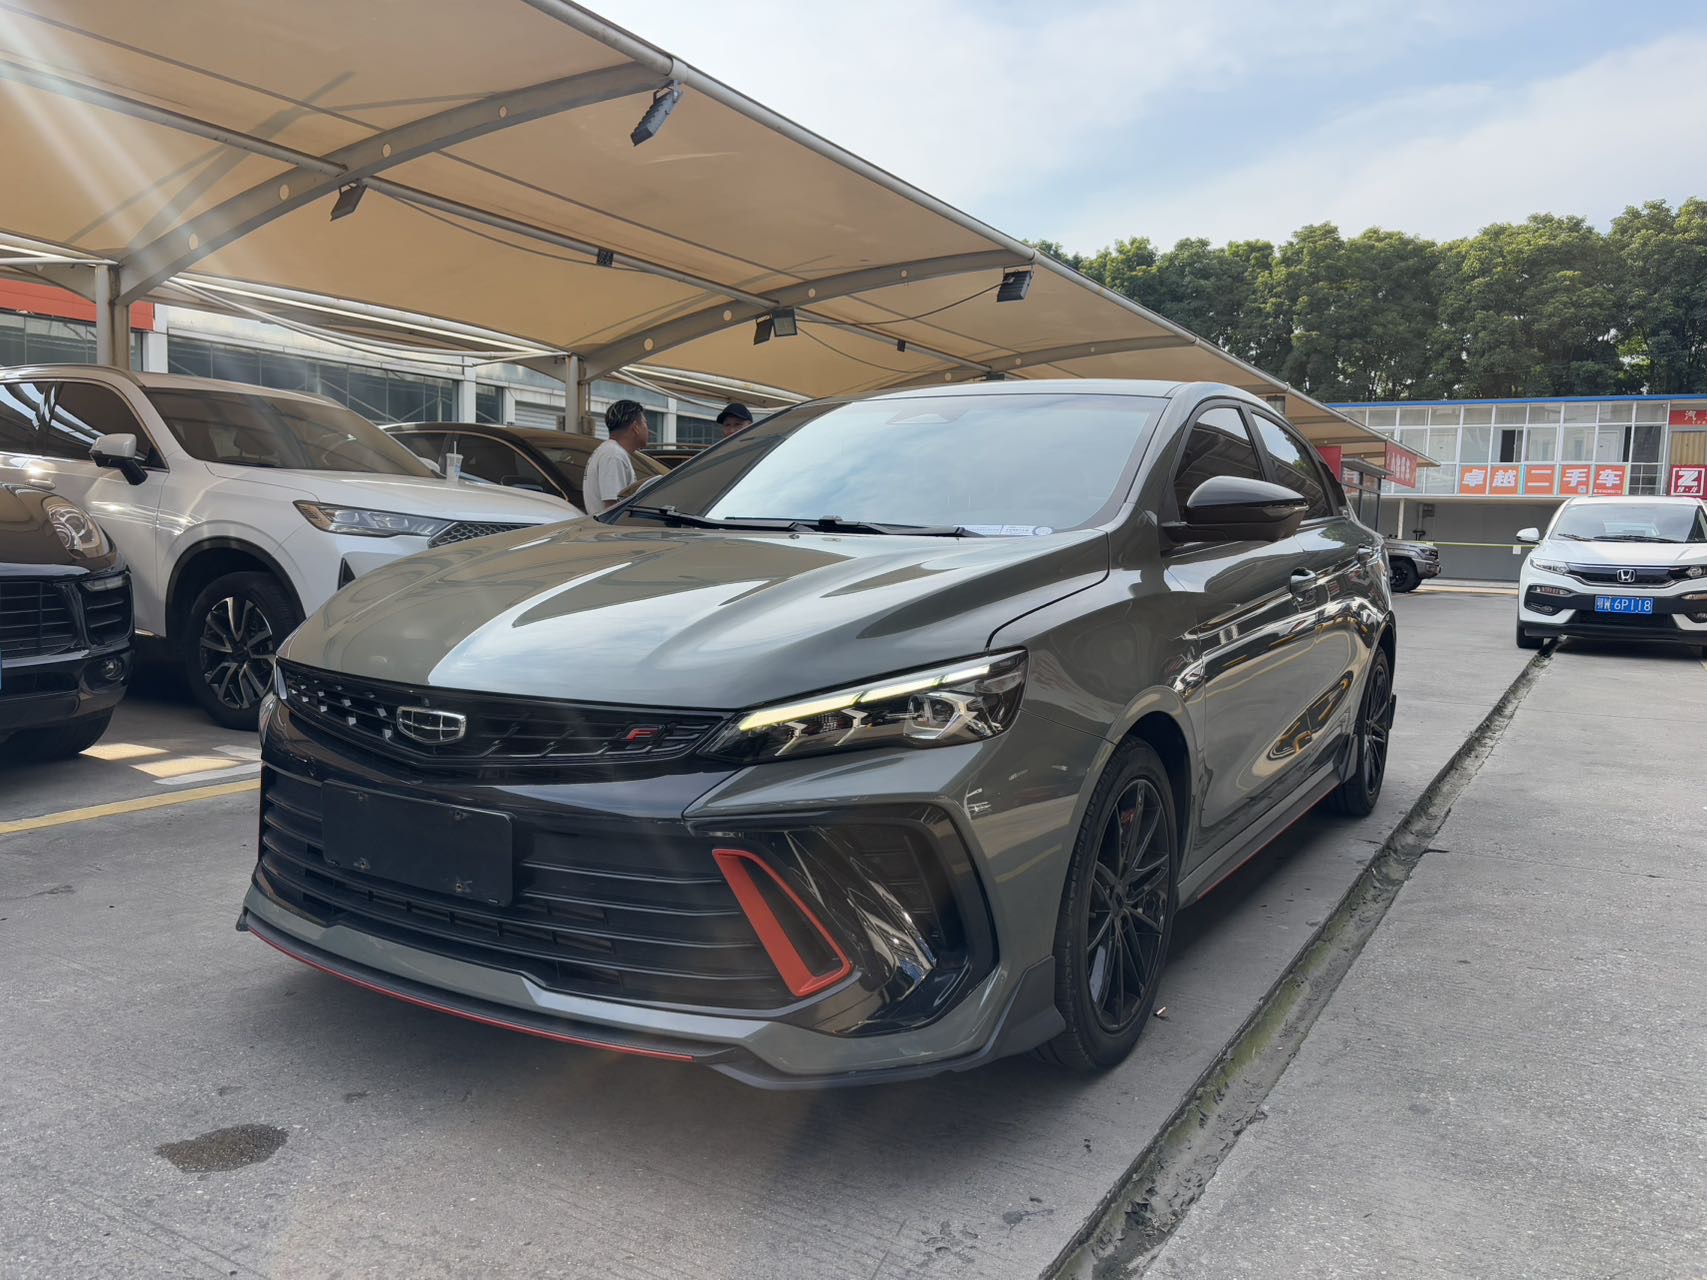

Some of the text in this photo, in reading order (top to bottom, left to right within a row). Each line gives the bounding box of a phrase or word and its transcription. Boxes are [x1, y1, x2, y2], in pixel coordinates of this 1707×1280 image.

[1461, 468, 1623, 488] 卓越二手车
